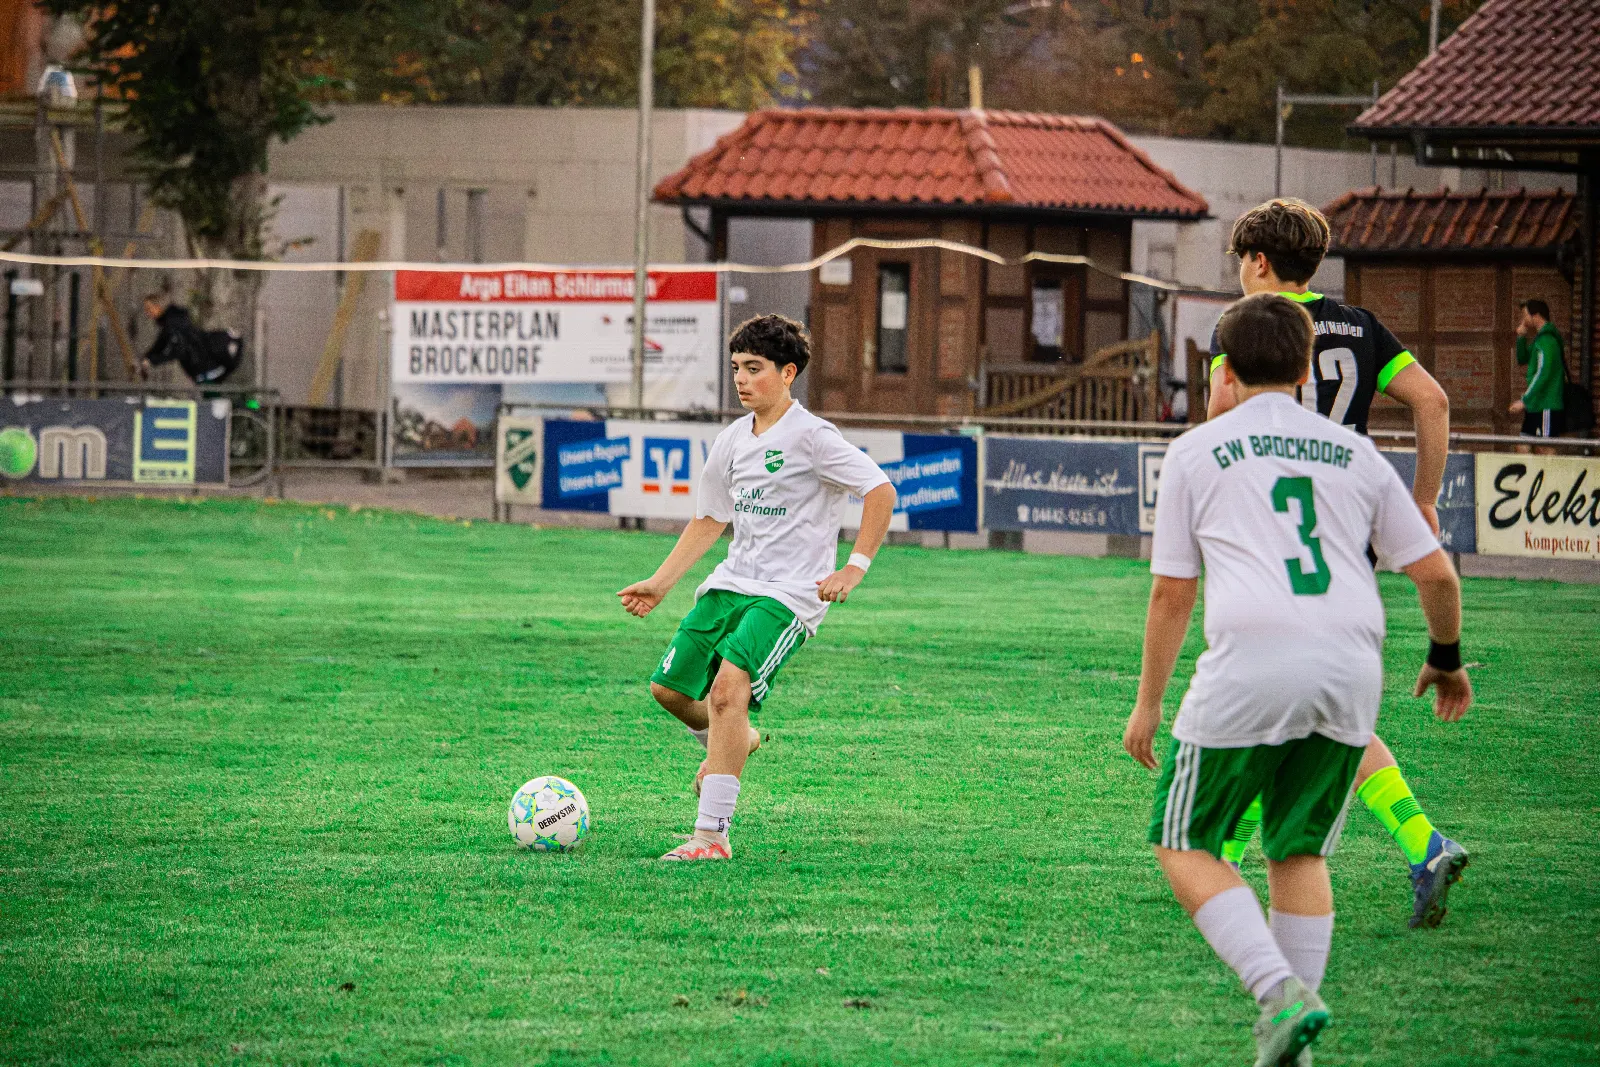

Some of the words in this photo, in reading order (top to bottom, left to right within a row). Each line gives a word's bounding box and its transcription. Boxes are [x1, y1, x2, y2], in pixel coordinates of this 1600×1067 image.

[554, 273, 657, 299] Schlarman
[409, 309, 560, 339] MASTERPLAN
[409, 344, 543, 375] BROCKDORF
[560, 449, 593, 466] Unsere
[1212, 438, 1246, 470] GW
[1248, 434, 1354, 469] BROCKDORF
[921, 457, 961, 476] werden
[560, 475, 593, 492] Unsere
[1270, 475, 1331, 596] 3
[1524, 531, 1591, 556] Kompetenz
[662, 646, 677, 675] 4
[538, 803, 577, 830] DERBYSTAR
